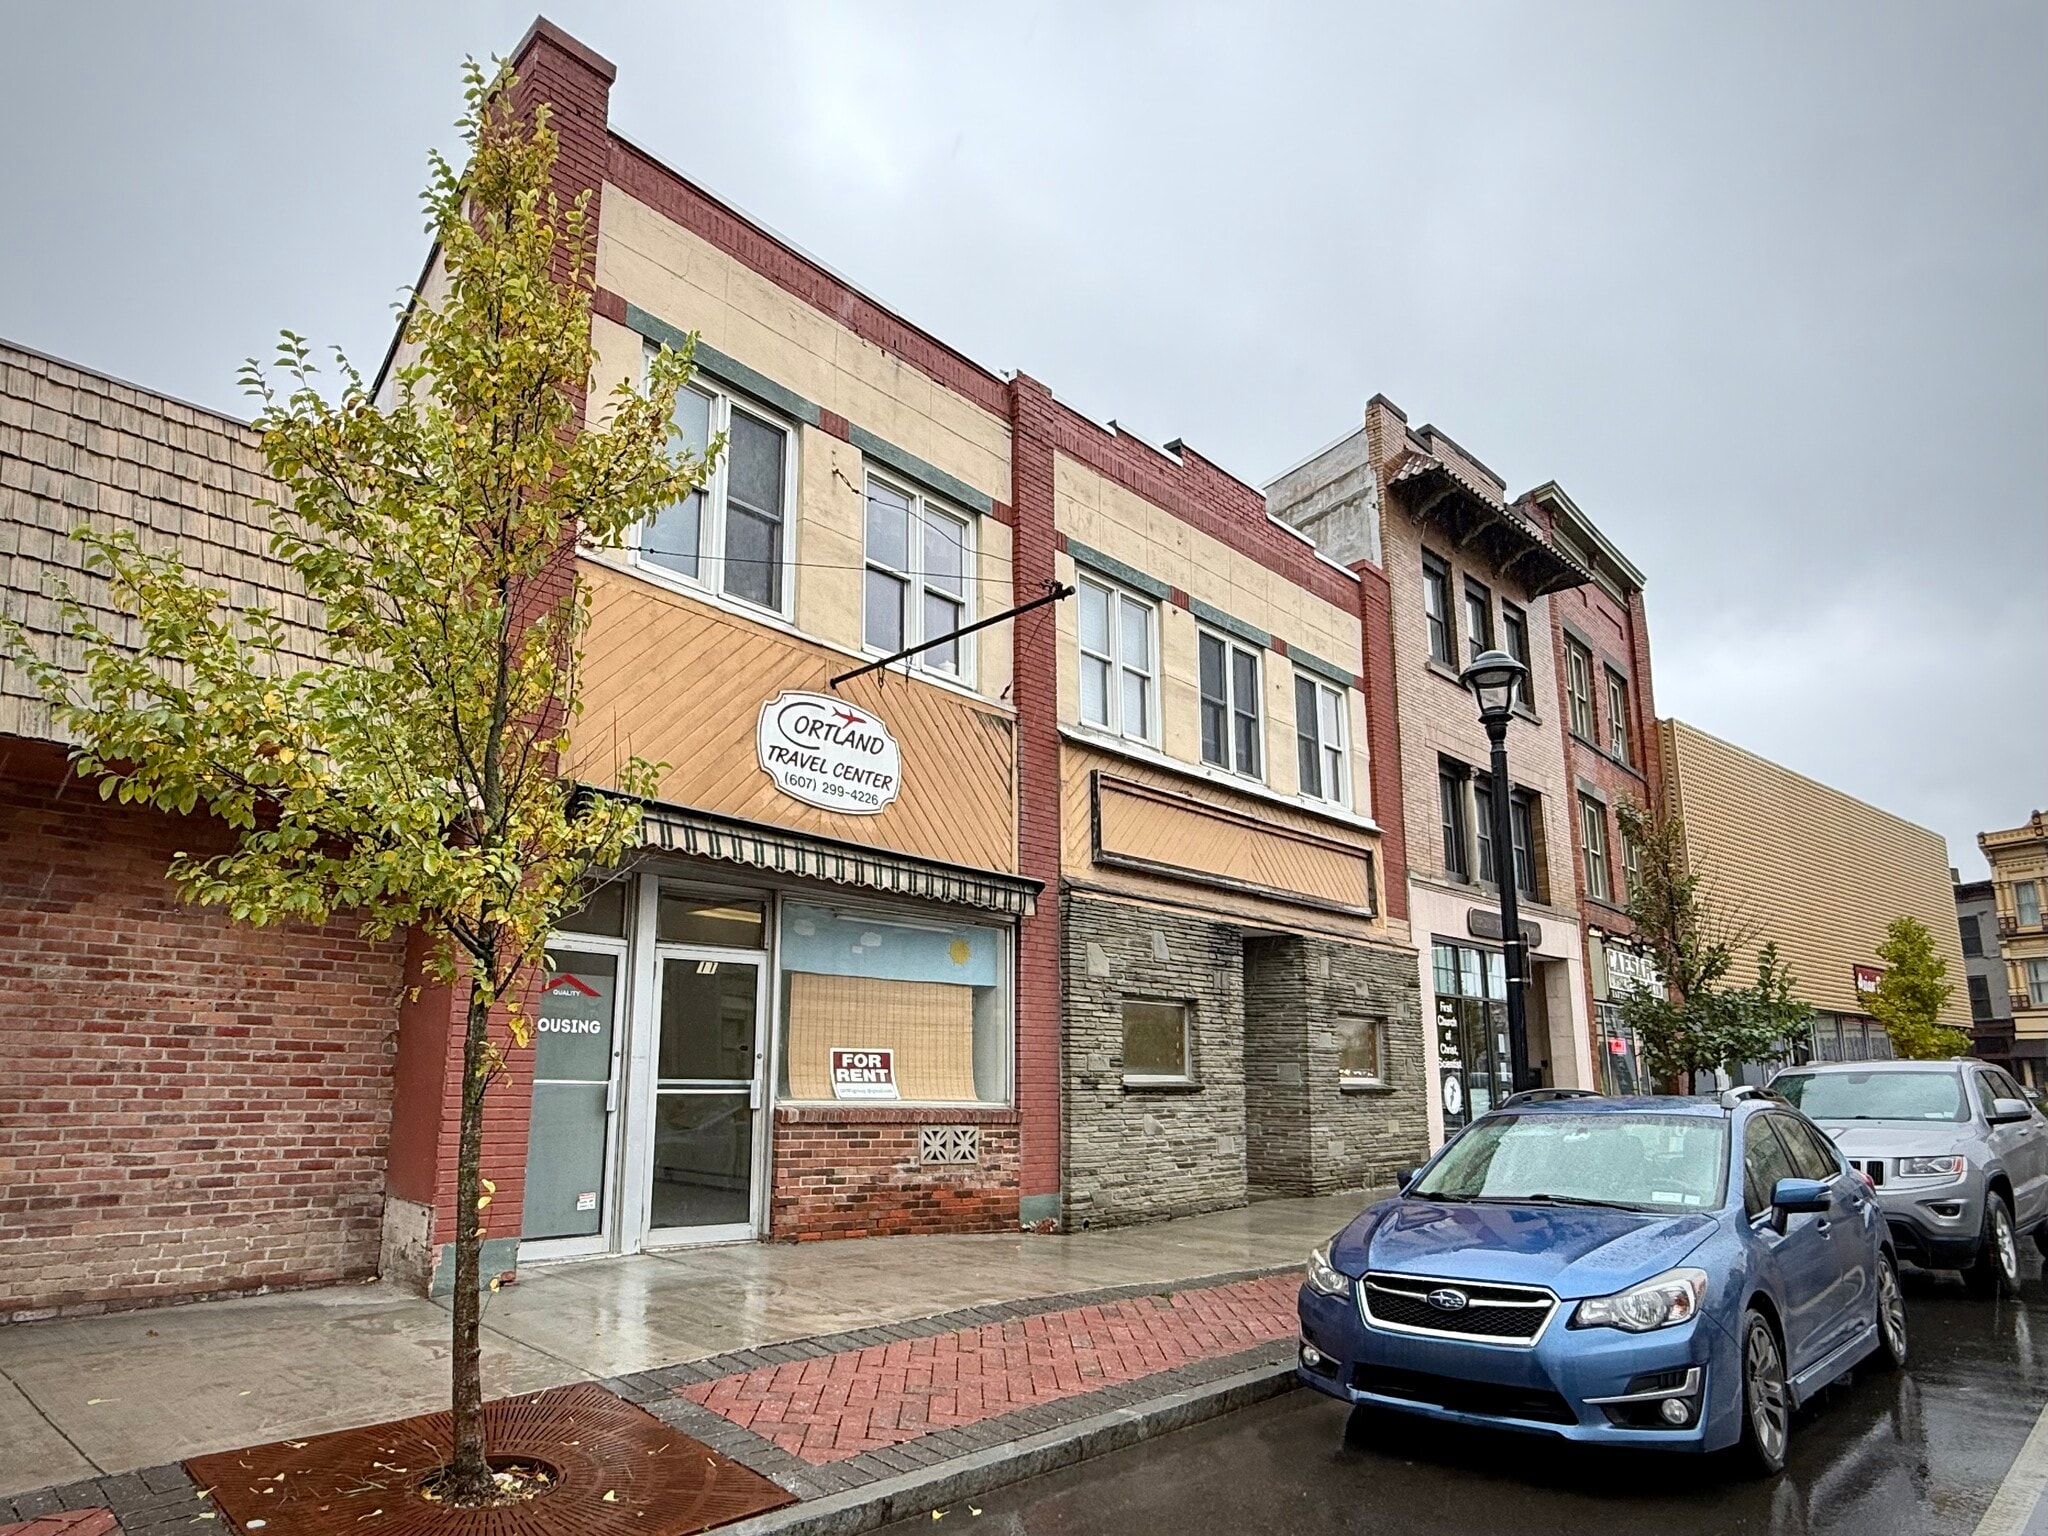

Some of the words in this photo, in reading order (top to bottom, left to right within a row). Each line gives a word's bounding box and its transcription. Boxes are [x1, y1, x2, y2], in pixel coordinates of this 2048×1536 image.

[777, 702, 885, 755] CORTLAND
[768, 745, 829, 774] TRAVEL
[833, 762, 893, 792] CENTER
[784, 771, 817, 792] (607)
[822, 782, 879, 806] 299-4226
[552, 989, 581, 997] QUALITY
[842, 1053, 882, 1068] FOR
[836, 1068, 889, 1082] RENT
